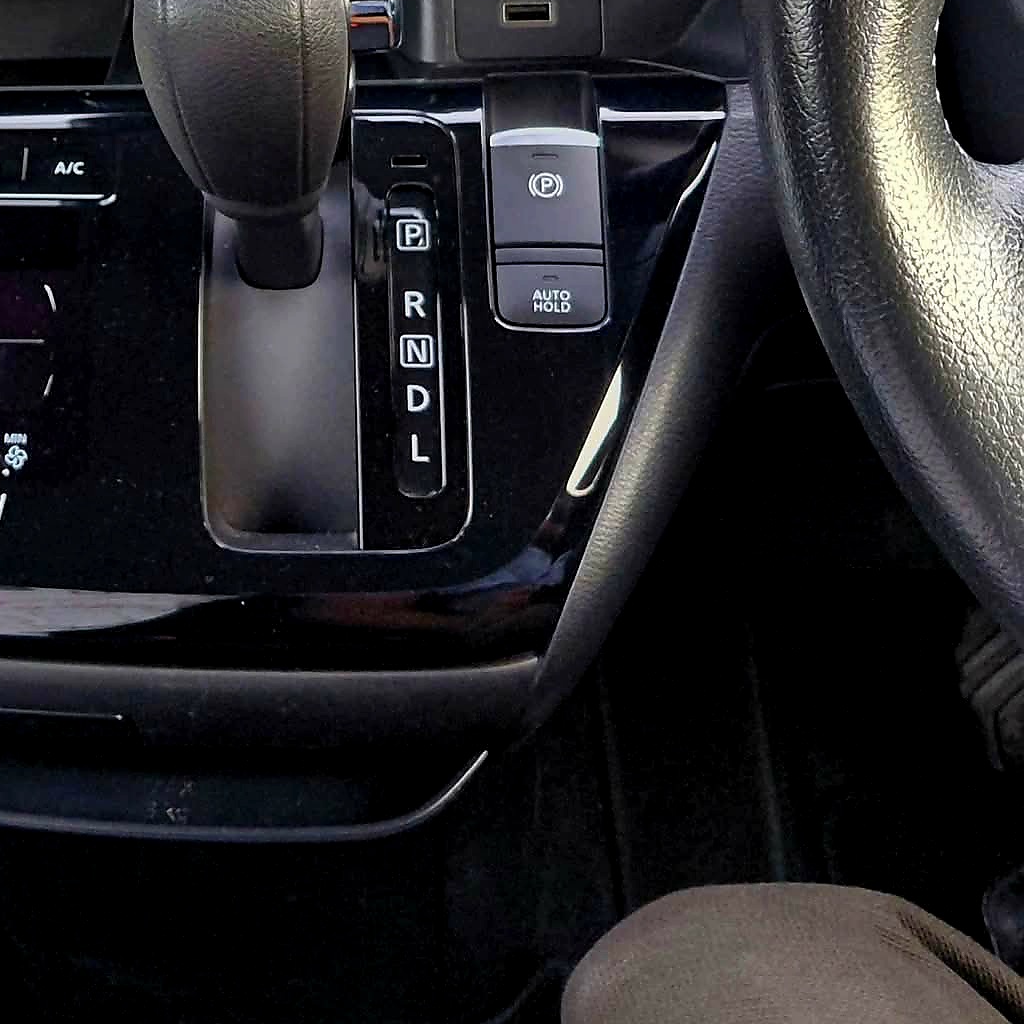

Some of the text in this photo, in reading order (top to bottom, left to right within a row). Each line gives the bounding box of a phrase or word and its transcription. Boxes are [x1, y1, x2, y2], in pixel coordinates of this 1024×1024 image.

[54, 161, 85, 176] A/C
[403, 291, 426, 318] R
[532, 289, 571, 302] AUTO
[533, 301, 571, 313] HOLD
[406, 384, 431, 412] D
[410, 433, 431, 463] L
